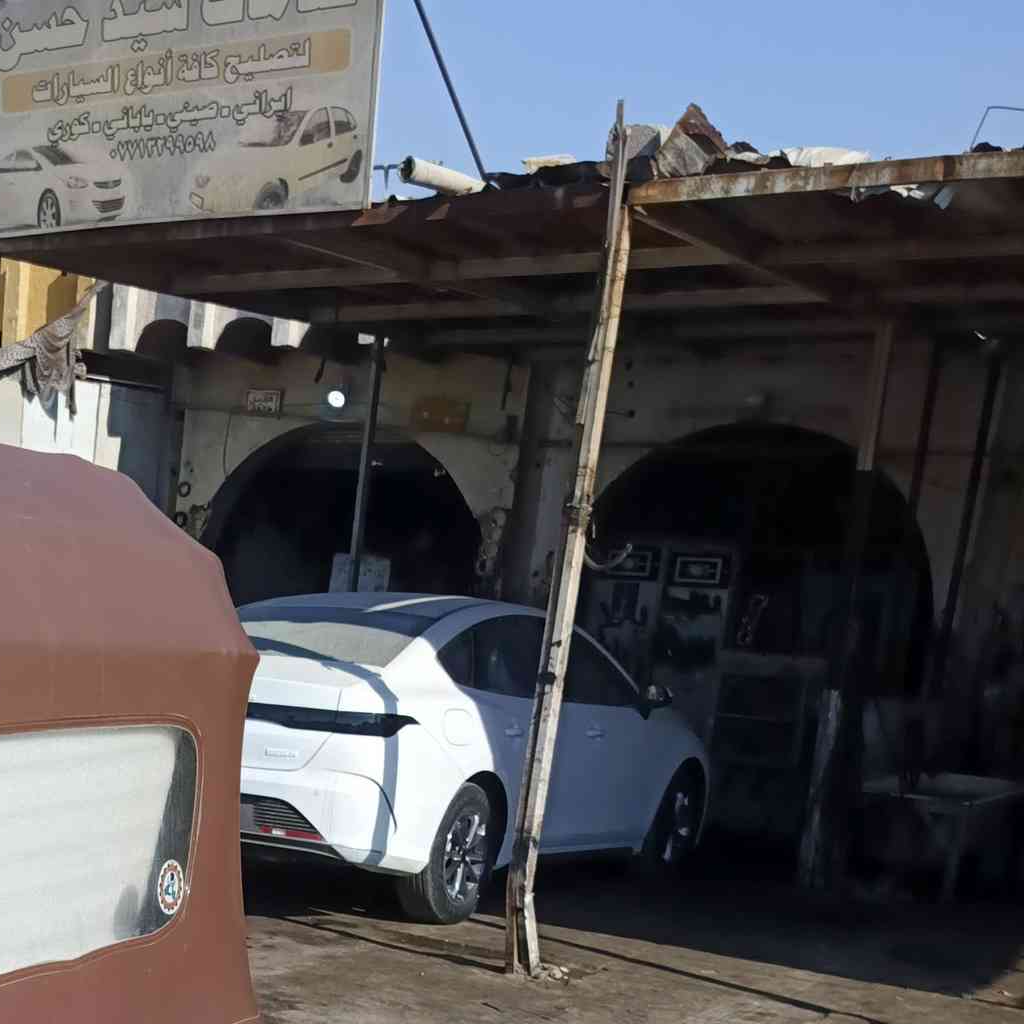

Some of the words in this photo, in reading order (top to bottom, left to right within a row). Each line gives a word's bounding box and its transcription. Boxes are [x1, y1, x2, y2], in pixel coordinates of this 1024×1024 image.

[124, 48, 173, 96] أنواع
[177, 49, 220, 83] كافة
[223, 39, 312, 84] لتصليح
[31, 65, 120, 105] السيارات
[46, 112, 91, 149] كوري
